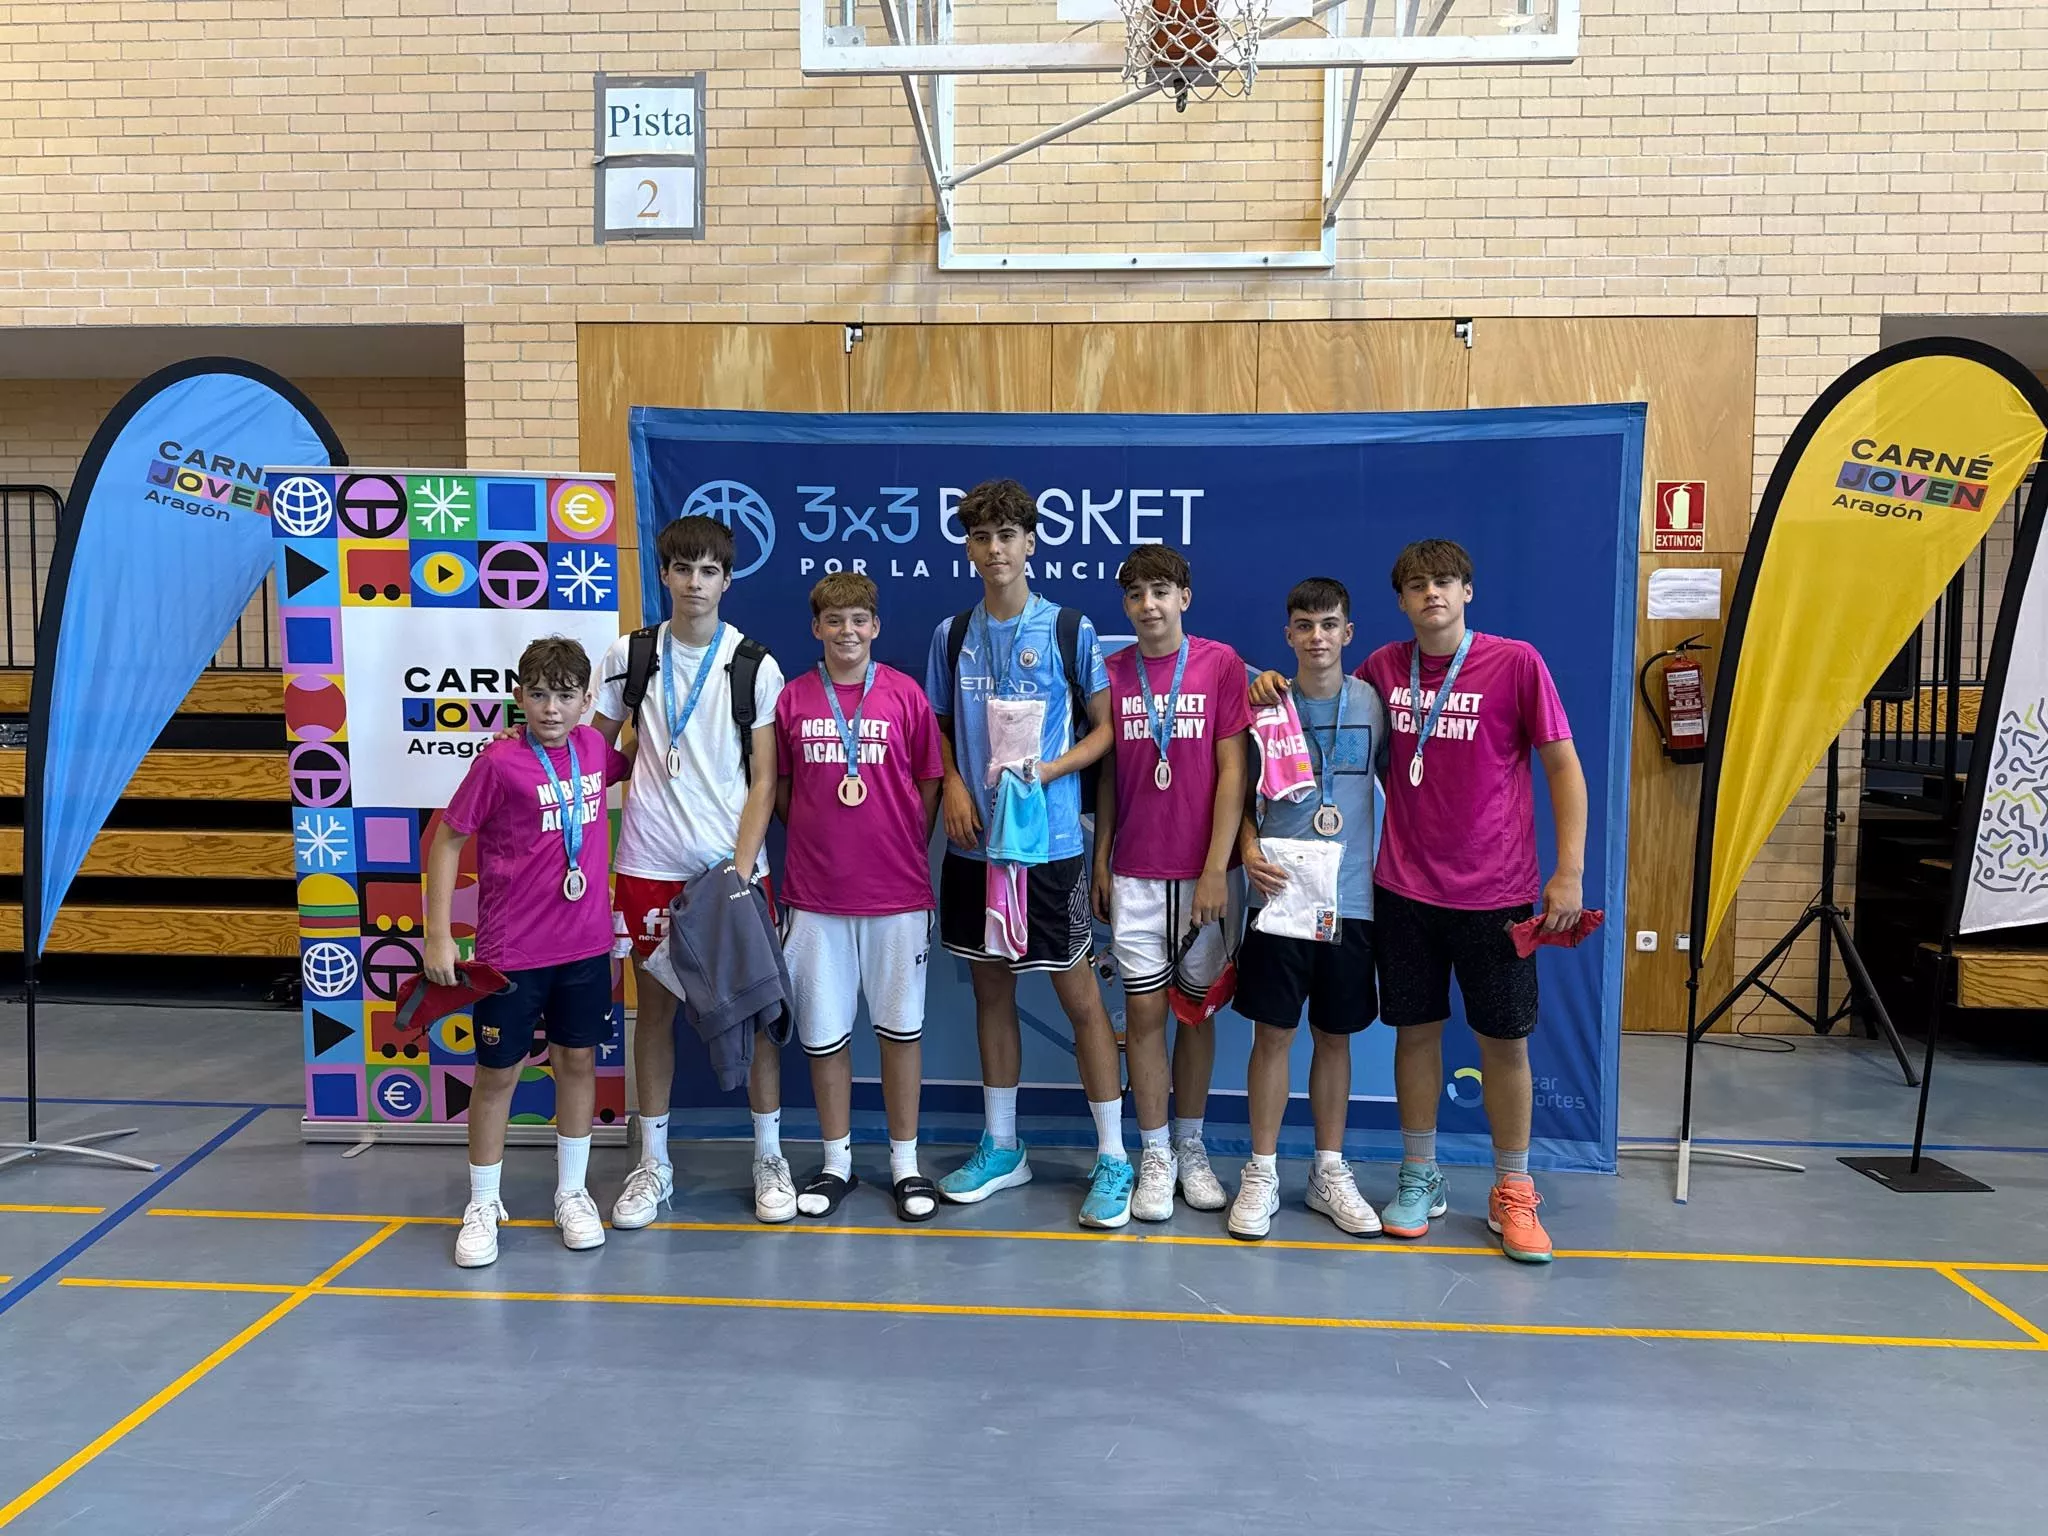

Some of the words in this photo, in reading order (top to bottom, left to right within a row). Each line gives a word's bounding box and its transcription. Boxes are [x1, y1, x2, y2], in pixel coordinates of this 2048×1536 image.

[608, 103, 694, 137] Pista
[637, 179, 660, 218] 2
[1851, 438, 1994, 481] CARNÉ
[1842, 467, 1985, 509] JOVEN
[144, 489, 231, 522] Aragón
[796, 486, 920, 544] 3x3
[939, 487, 1205, 546] BSKET
[1831, 493, 1924, 522] Aragón
[1656, 535, 1702, 547] EXTINTOR
[800, 558, 869, 576] POR
[891, 559, 931, 578] LA
[408, 702, 527, 728] JOVE
[407, 737, 488, 758] Aragó
